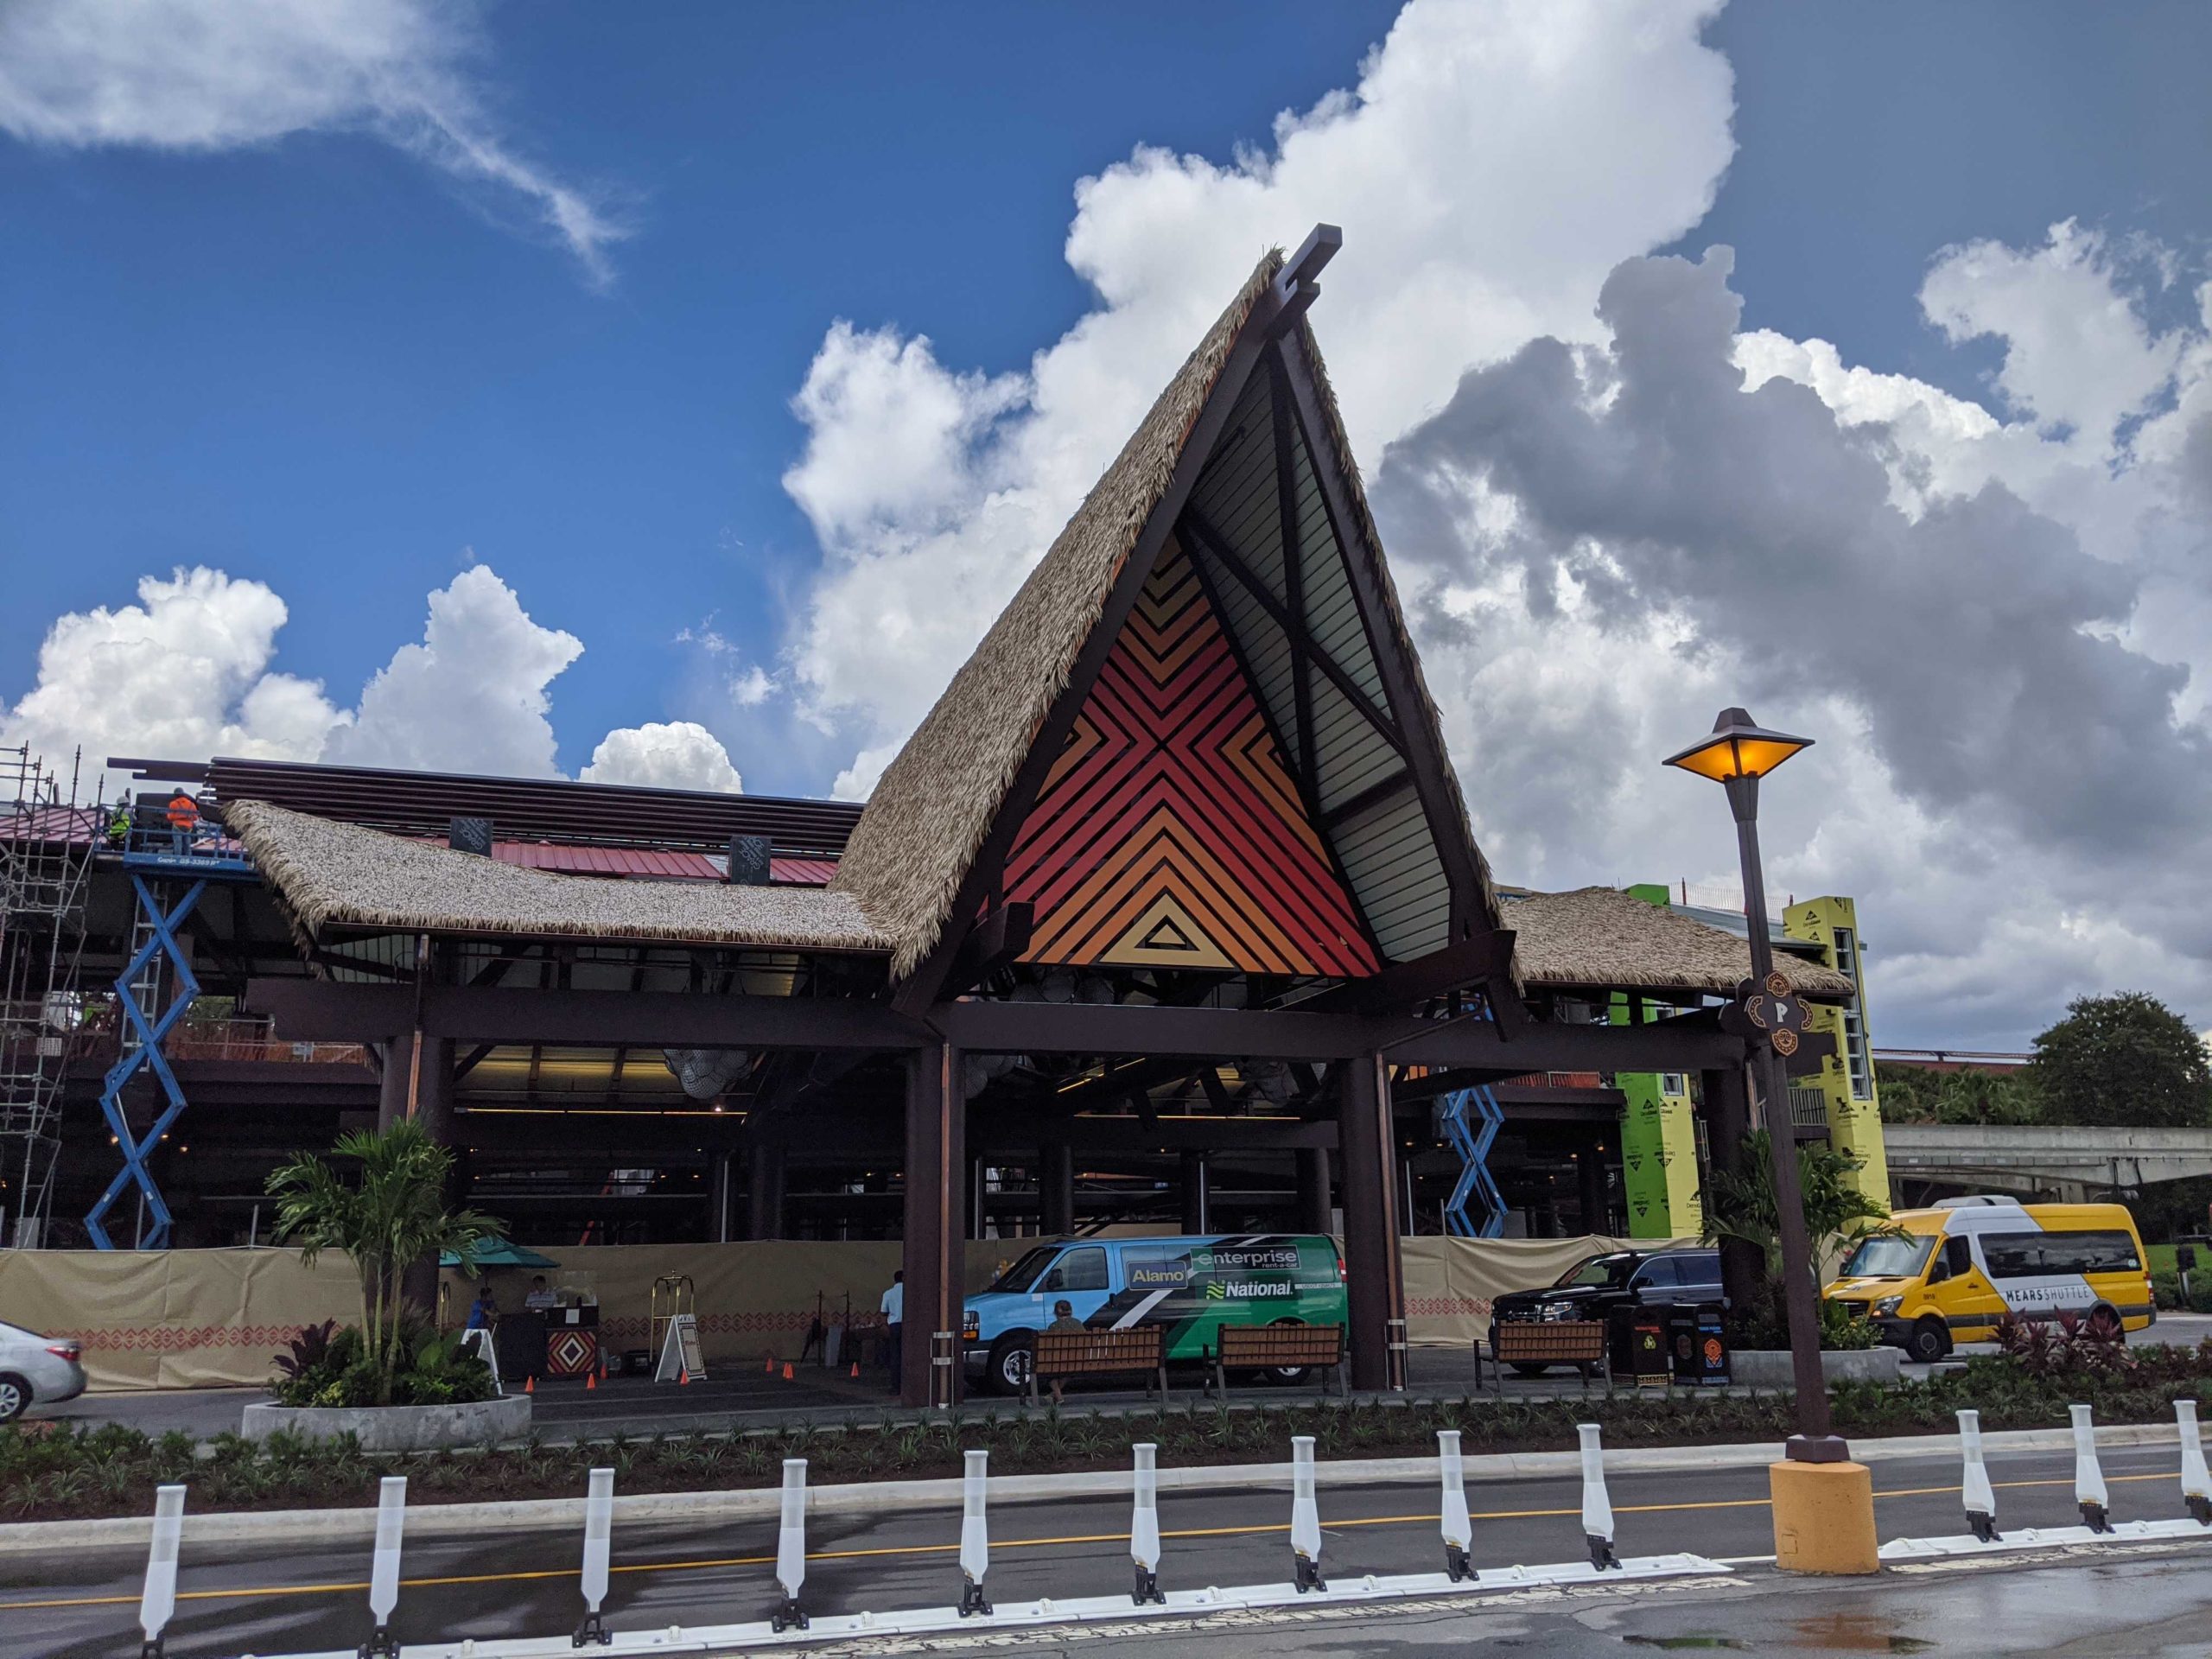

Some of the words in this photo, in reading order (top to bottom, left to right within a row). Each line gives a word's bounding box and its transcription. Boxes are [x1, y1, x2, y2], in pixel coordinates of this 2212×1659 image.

[1775, 1002, 1789, 1023] P
[1192, 1249, 1297, 1267] enterprise
[1132, 1269, 1185, 1283] Alamo
